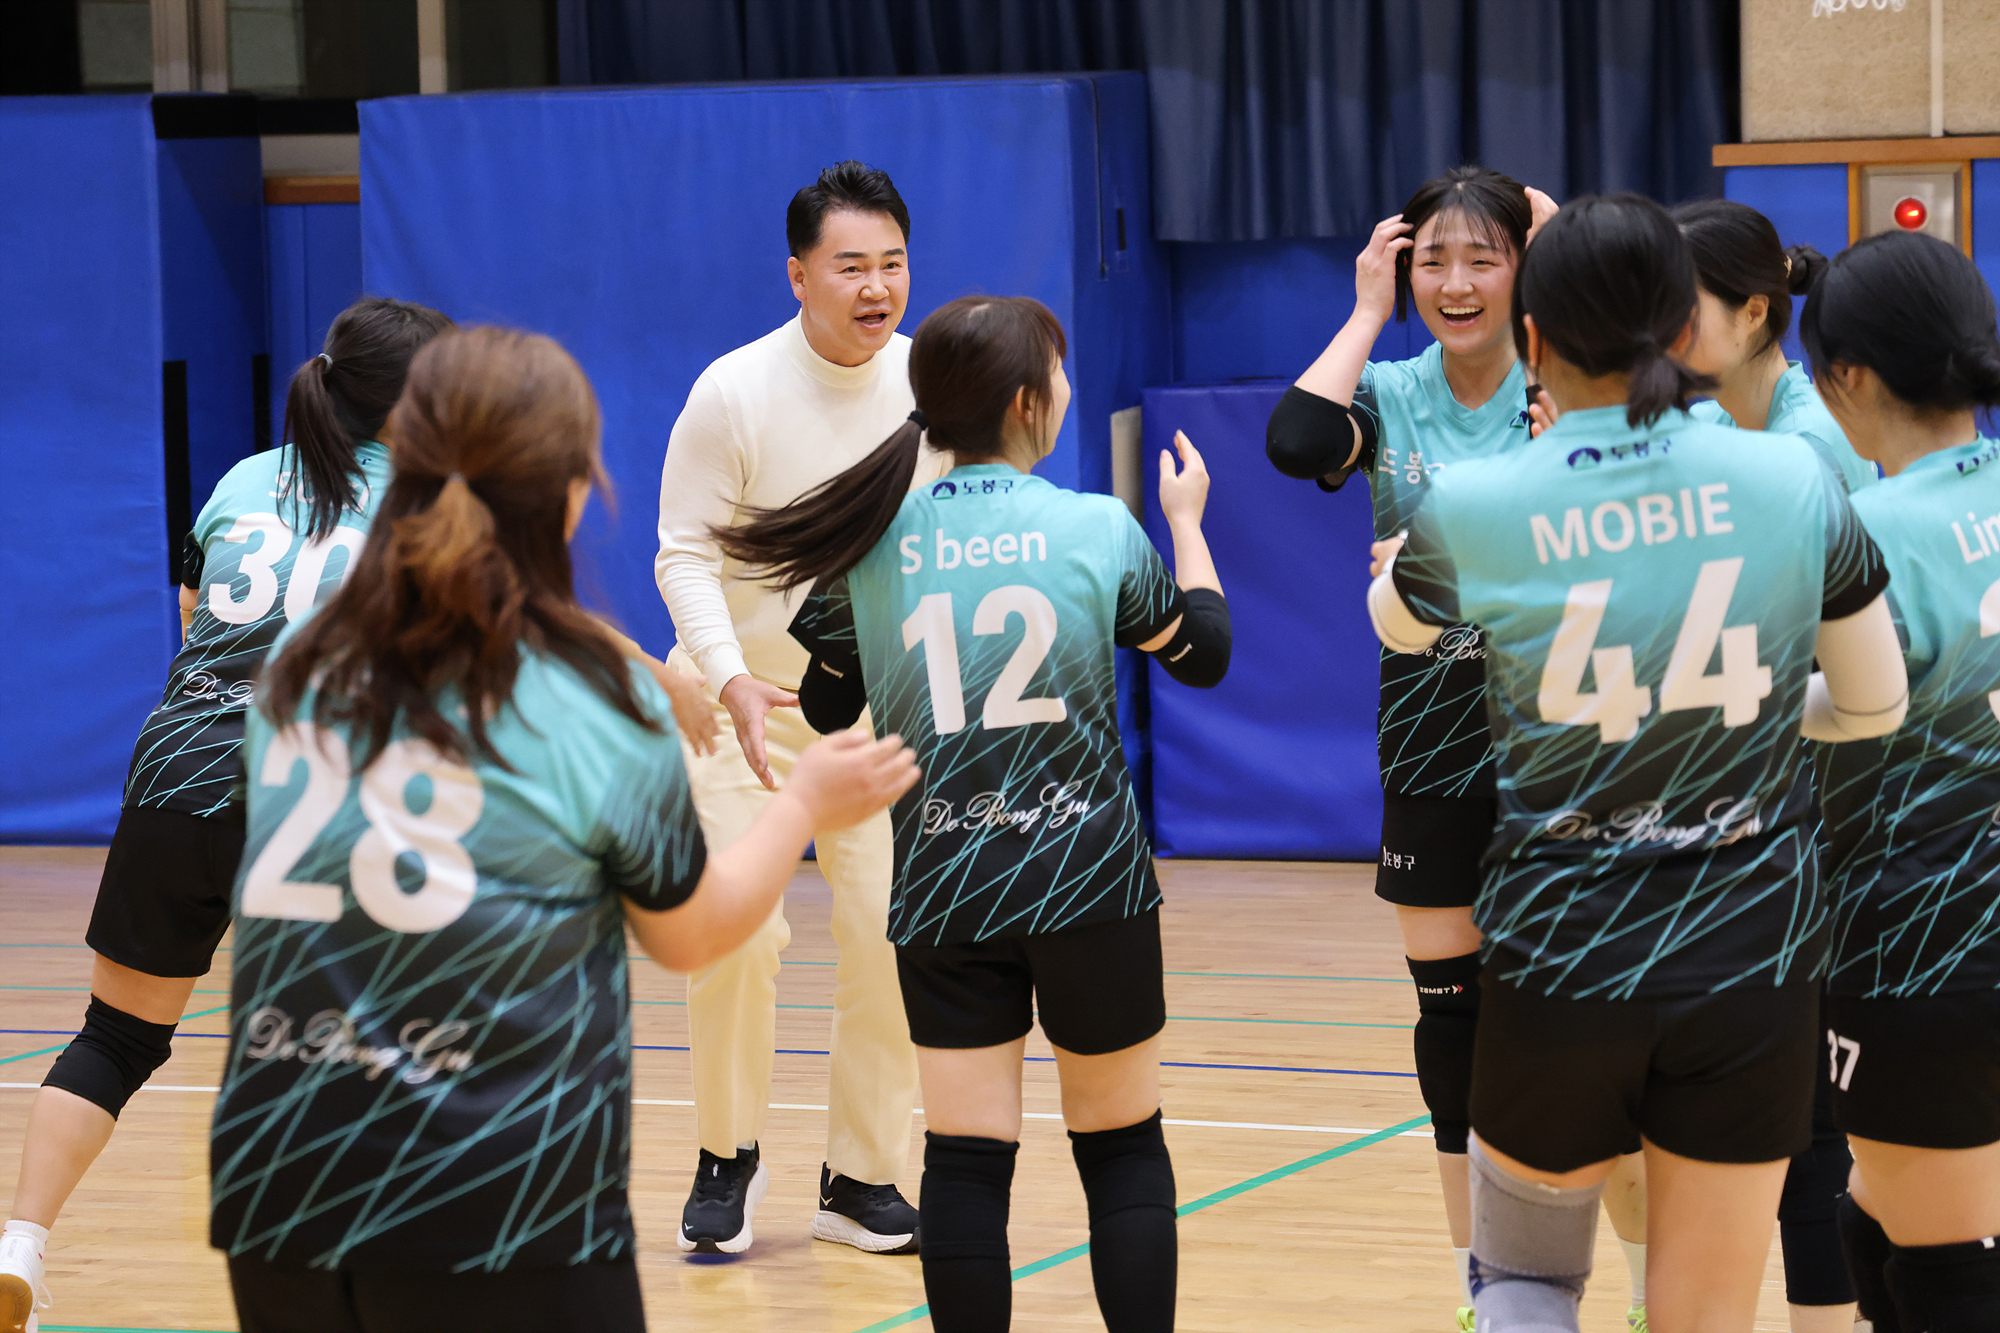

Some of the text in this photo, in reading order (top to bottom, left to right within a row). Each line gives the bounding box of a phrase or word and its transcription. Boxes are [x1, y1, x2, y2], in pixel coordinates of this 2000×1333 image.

[963, 480, 1014, 495] 도봉구
[899, 528, 1047, 575] S been
[1530, 482, 1735, 565] MOBIE
[208, 512, 368, 625] 30
[902, 584, 1068, 735] 12
[1537, 556, 1773, 744] 44
[241, 721, 485, 934] 28
[923, 780, 1091, 835] Do Bong Gu
[1603, 801, 1708, 850] Bong
[1386, 852, 1416, 871] 도봉구
